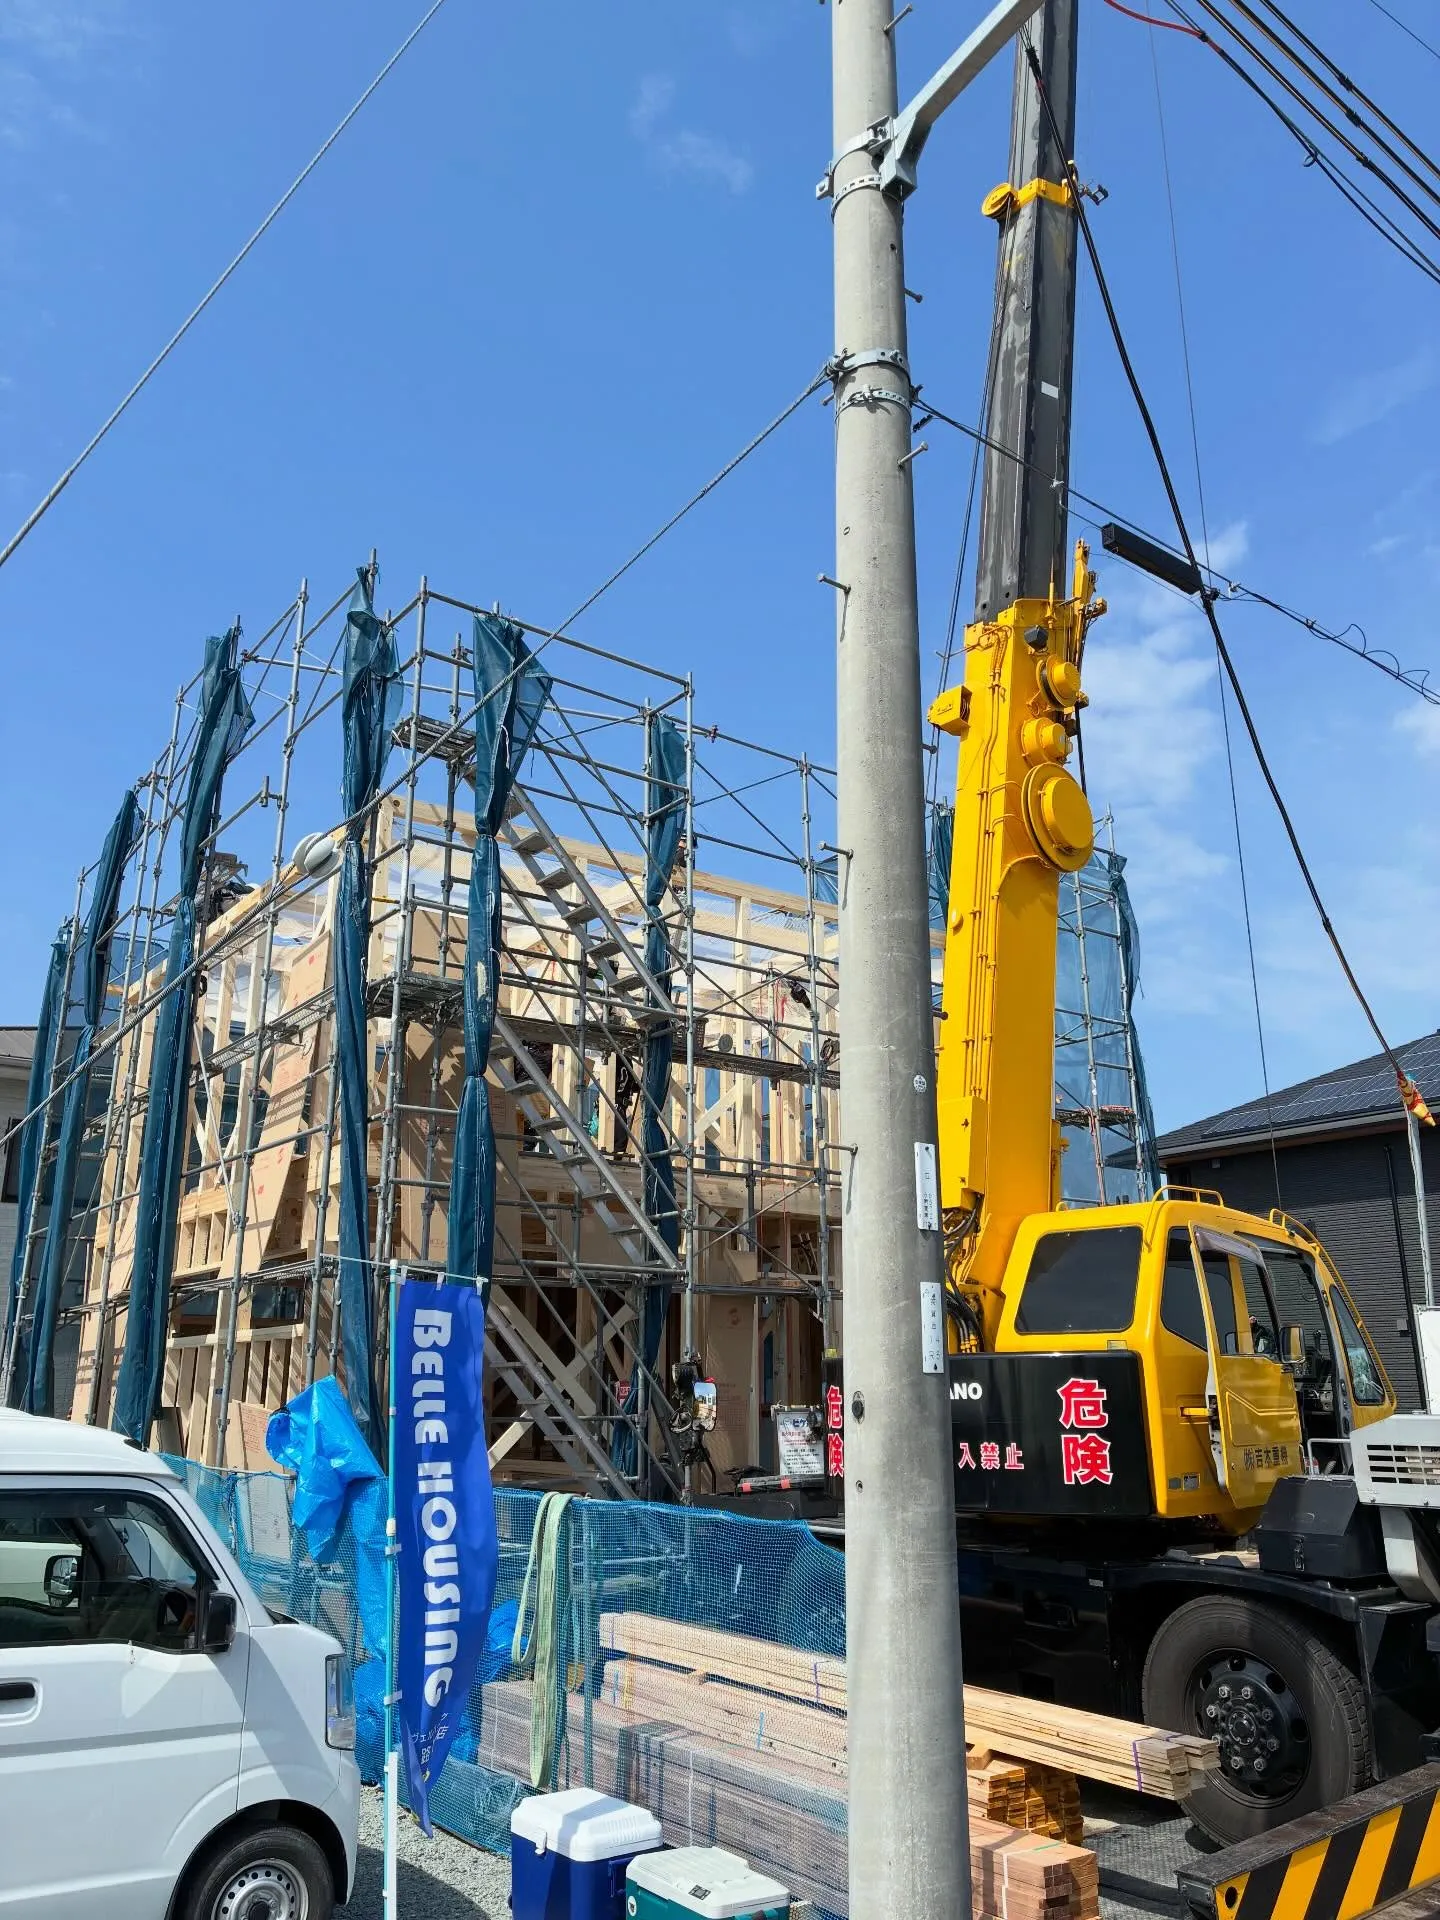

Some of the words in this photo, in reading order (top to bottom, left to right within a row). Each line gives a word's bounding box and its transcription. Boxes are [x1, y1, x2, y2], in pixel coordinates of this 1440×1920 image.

[412, 1309, 452, 1444] BELLE
[827, 1384, 844, 1478] 危険
[1056, 1377, 1113, 1486] 危険
[417, 1461, 461, 1708] HOUSING
